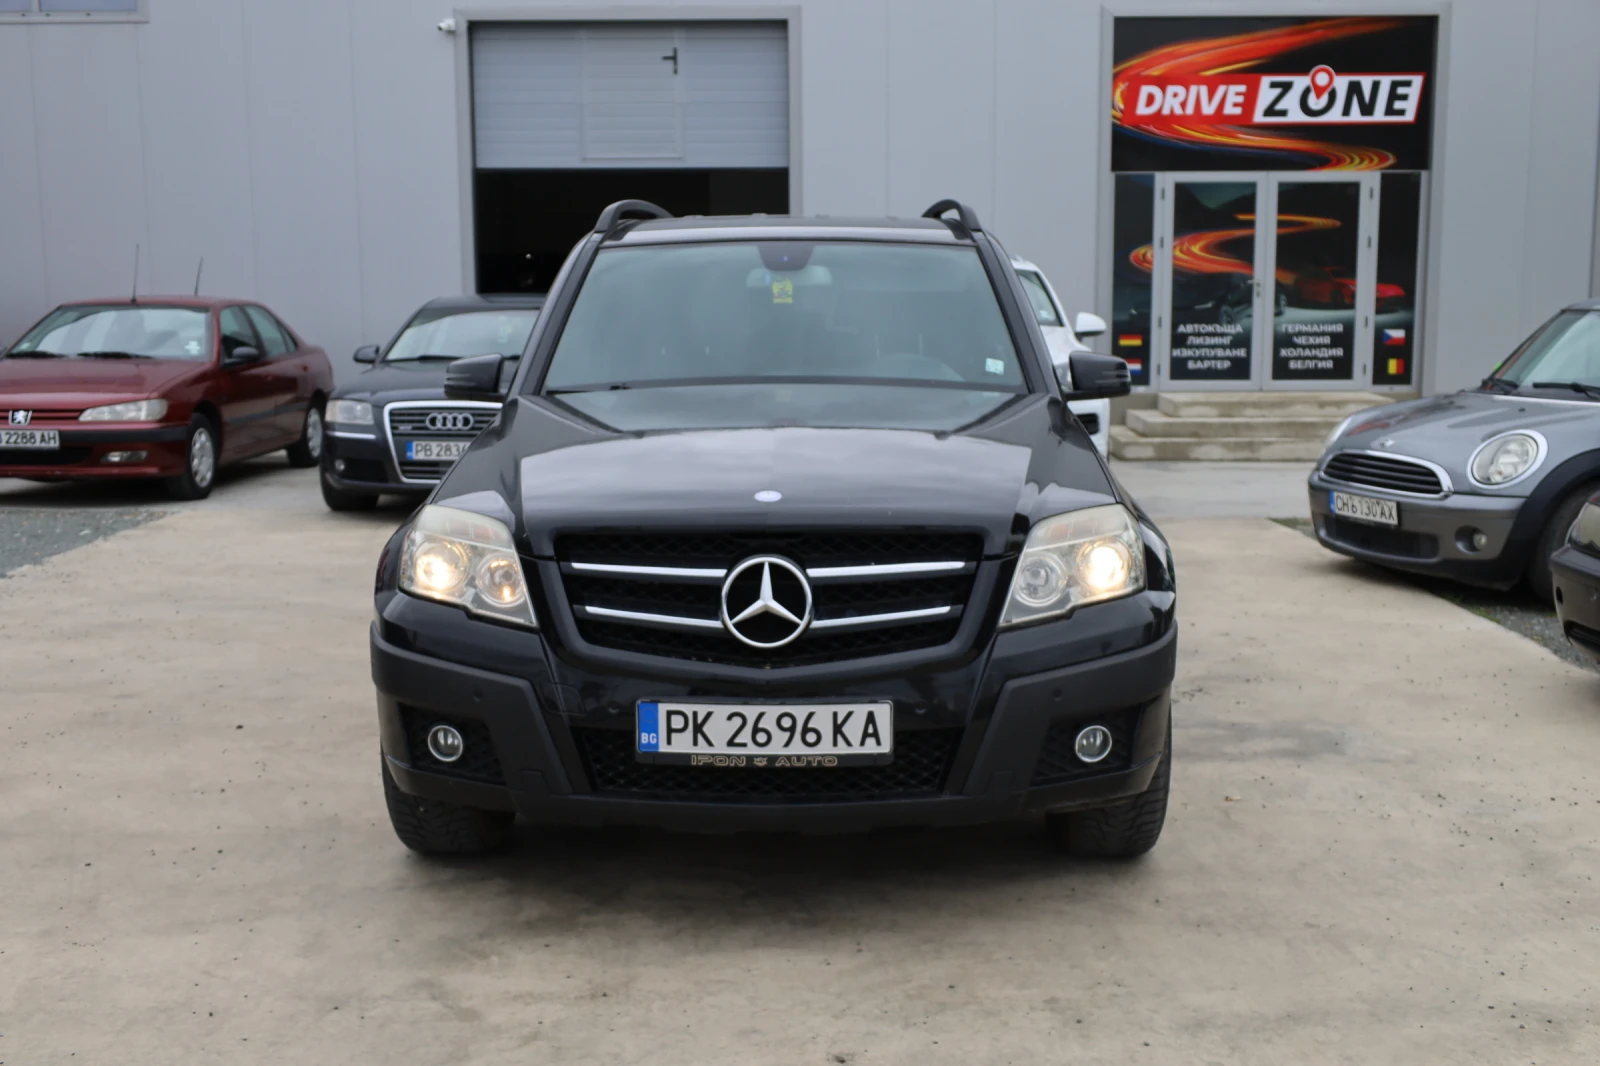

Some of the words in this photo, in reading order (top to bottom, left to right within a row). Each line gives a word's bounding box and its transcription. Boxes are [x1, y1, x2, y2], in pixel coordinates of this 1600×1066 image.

[1135, 85, 1247, 115] DRIVE
[1262, 79, 1413, 118] ZONE
[1177, 323, 1243, 334] АВТОКЪЩА
[1282, 323, 1344, 333] ГЕРМАНИЯ
[1186, 336, 1233, 345] ЛИЗИНГ
[1292, 335, 1331, 345] ЧЕХИЯ
[1172, 348, 1247, 358] ИЗКУПУВАНЕ
[1280, 347, 1344, 358] ХОЛАНДИЯ
[1187, 360, 1232, 370] БАРТЕР
[1289, 359, 1334, 369] БЕЛГИЯ
[5, 432, 36, 445] 2288
[40, 432, 57, 445] AH
[665, 710, 715, 747] PK
[726, 711, 822, 748] 2696
[832, 710, 882, 747] KA
[641, 732, 657, 744] BG
[775, 755, 838, 766] AUTO
